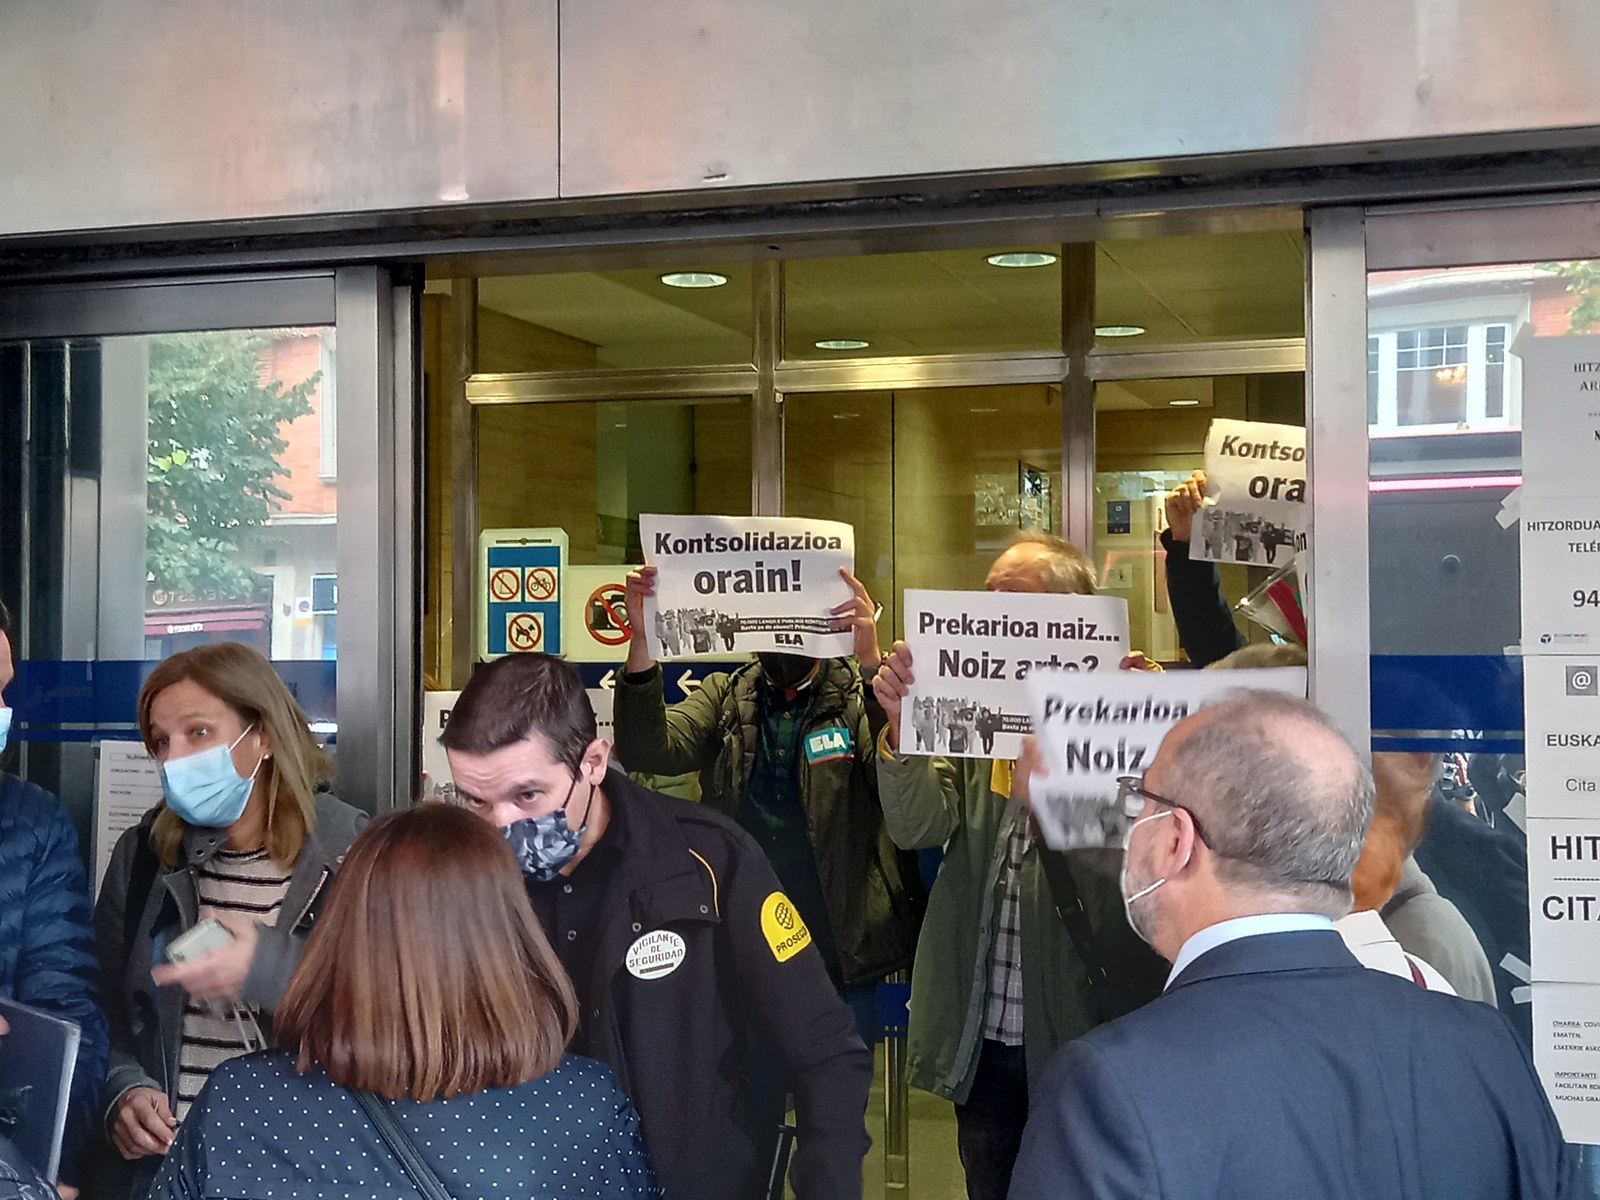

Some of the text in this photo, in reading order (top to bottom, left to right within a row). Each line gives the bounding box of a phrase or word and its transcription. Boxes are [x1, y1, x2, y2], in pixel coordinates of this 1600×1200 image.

[1580, 381, 1600, 391] AR
[1220, 435, 1305, 462] Kontso
[1249, 476, 1306, 503] ora
[1527, 521, 1600, 531] HITZORDUA
[655, 532, 841, 555] Kontsolidazioa
[694, 560, 801, 594] orain!
[1573, 590, 1600, 608] 94
[919, 612, 1120, 642] Prekarioa naiz...
[774, 633, 804, 646] ELA
[938, 649, 1006, 680] Noiz
[1043, 695, 1188, 723] Prekarioa
[809, 732, 847, 753] ELA
[1547, 734, 1600, 747] EUSKA
[1066, 738, 1147, 772] Noiz
[1566, 778, 1596, 792] Cita
[1551, 835, 1600, 860] HIT
[1542, 895, 1600, 921] CIT
[633, 933, 679, 956] VIGILANTE
[650, 945, 661, 953] DE
[629, 948, 683, 968] SEGURIDAD
